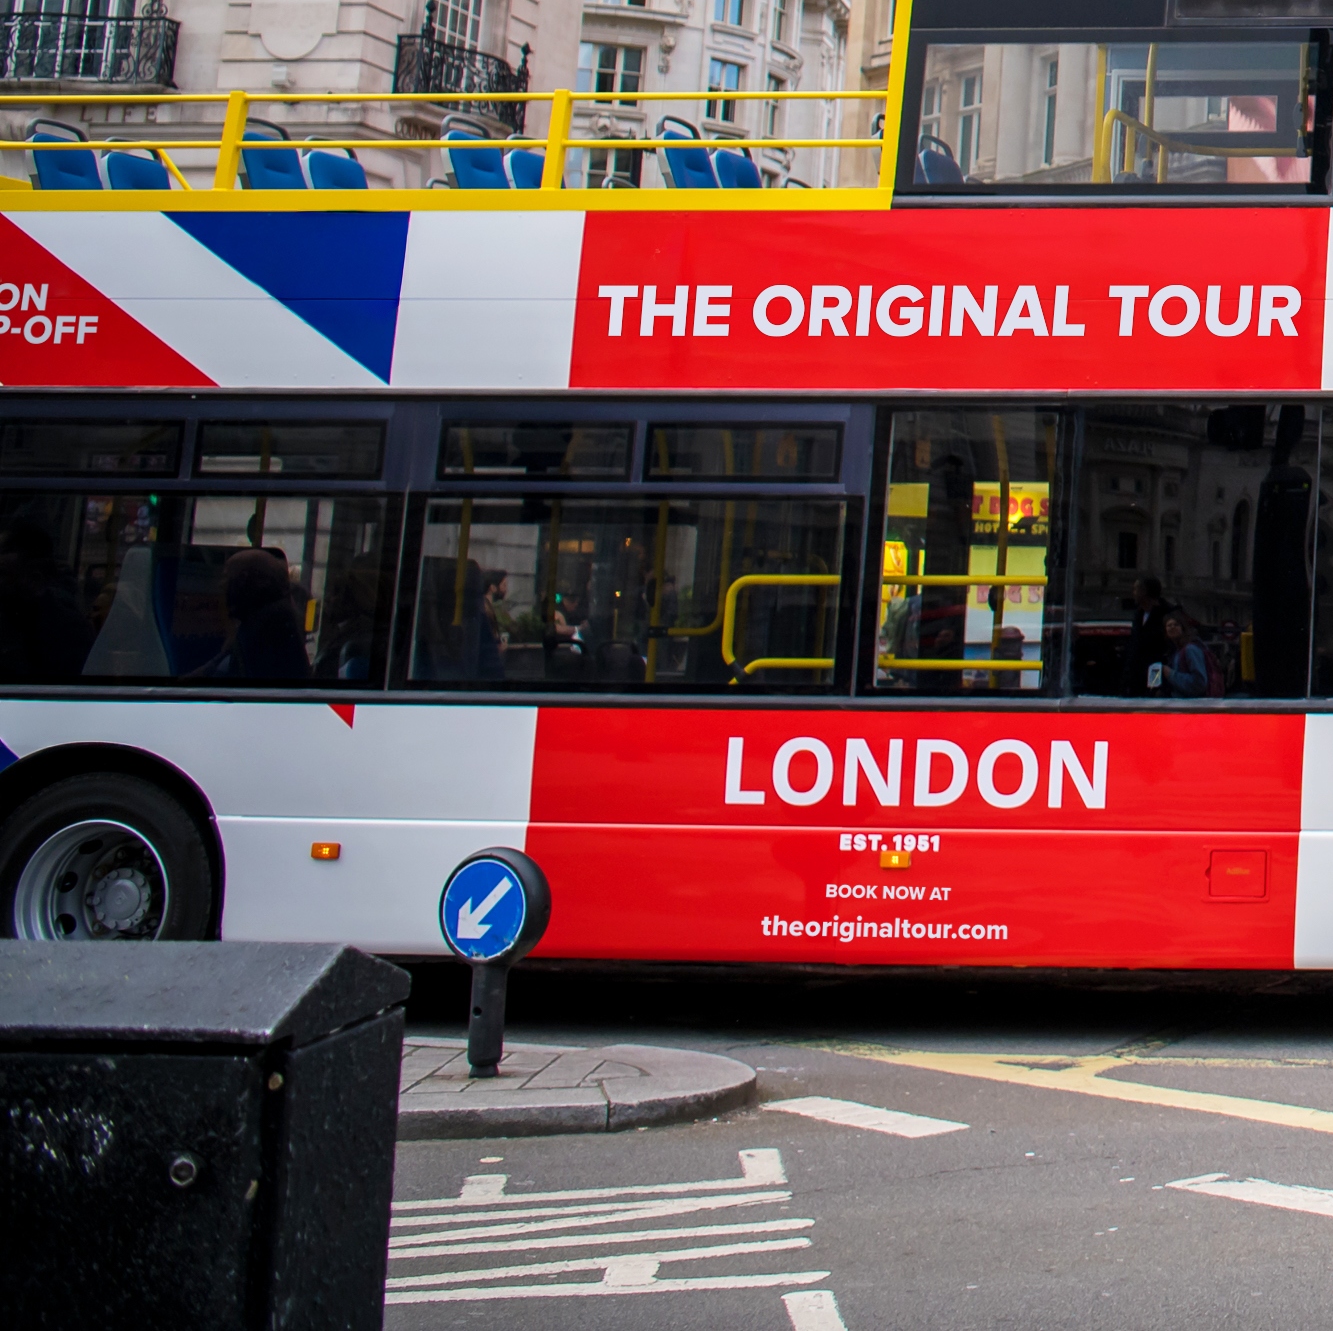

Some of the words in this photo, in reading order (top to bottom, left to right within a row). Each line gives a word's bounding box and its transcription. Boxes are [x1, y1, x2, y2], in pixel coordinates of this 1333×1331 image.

[597, 285, 733, 337] THE
[752, 284, 1086, 337] ORIGINAL
[1108, 284, 1302, 337] TOUR
[724, 736, 1109, 809] LONDON
[839, 833, 888, 852] EST.
[892, 834, 940, 853] 1951
[825, 884, 878, 899] BOOK
[882, 886, 926, 900] NOW
[929, 887, 952, 901] AT
[761, 914, 1008, 943] theoriginaltour.com
